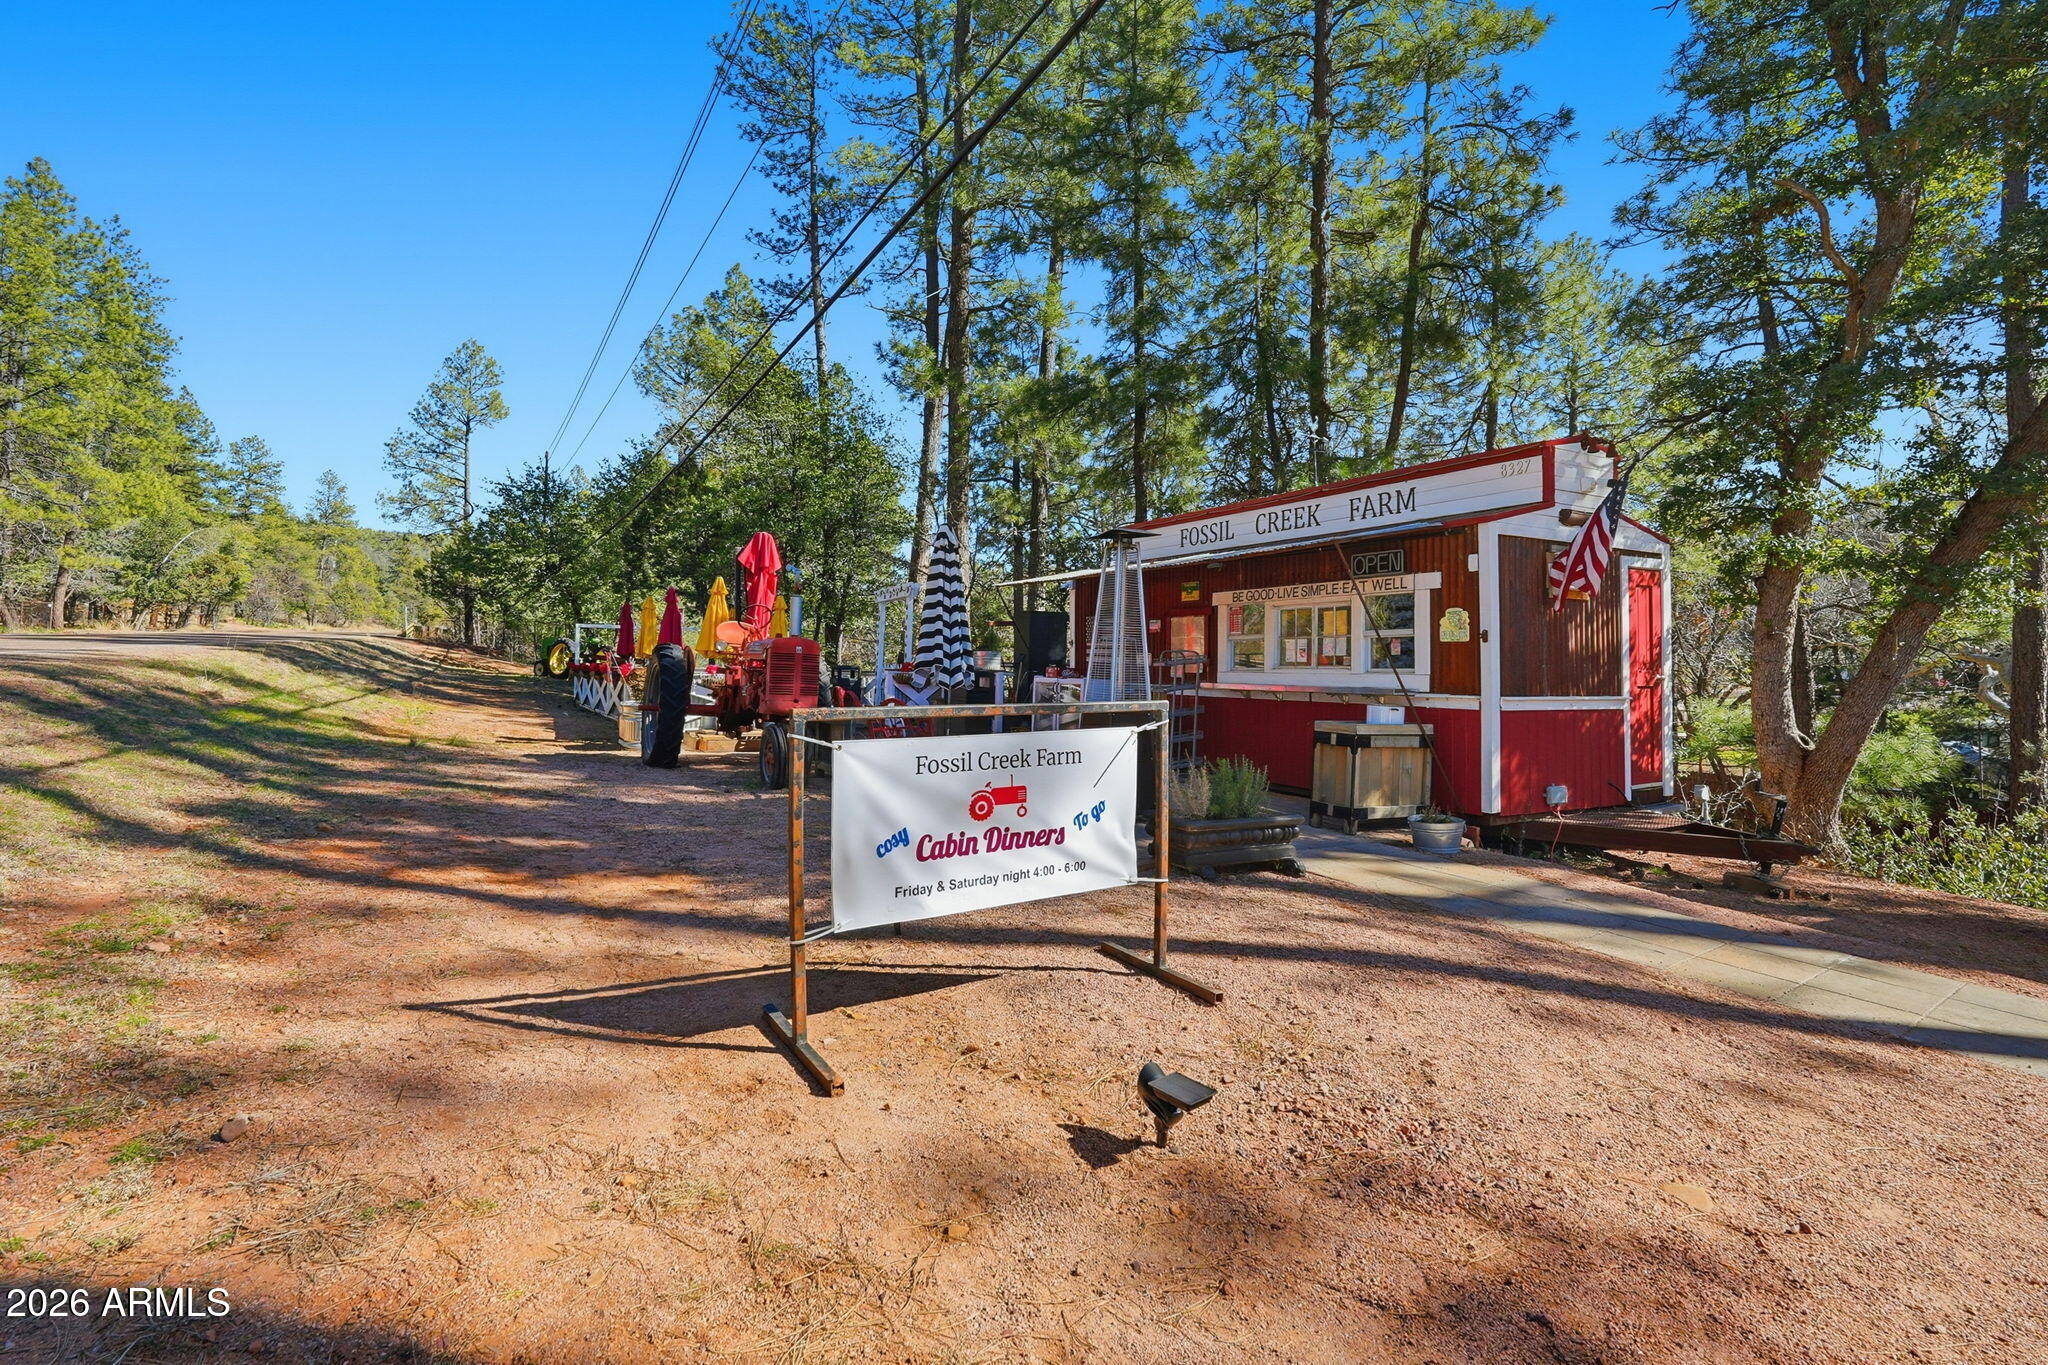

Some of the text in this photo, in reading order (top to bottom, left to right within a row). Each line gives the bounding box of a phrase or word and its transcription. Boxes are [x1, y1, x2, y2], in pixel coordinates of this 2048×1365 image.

[1501, 459, 1530, 478] 8327
[1180, 486, 1417, 548] FOSSIL CREEK FARM
[1354, 552, 1401, 575] OPEN
[1232, 591, 1244, 603] BE
[1371, 577, 1408, 591] WELL
[915, 748, 1083, 775] Fossil Creek Farm
[876, 799, 1107, 862] cosy Cabin Dinners To go
[894, 883, 933, 898] Friday
[936, 880, 945, 892] &
[949, 873, 1000, 891] Saturday
[1002, 869, 1031, 883] night
[1033, 864, 1055, 877] 4:00
[1065, 860, 1086, 873] 6:00
